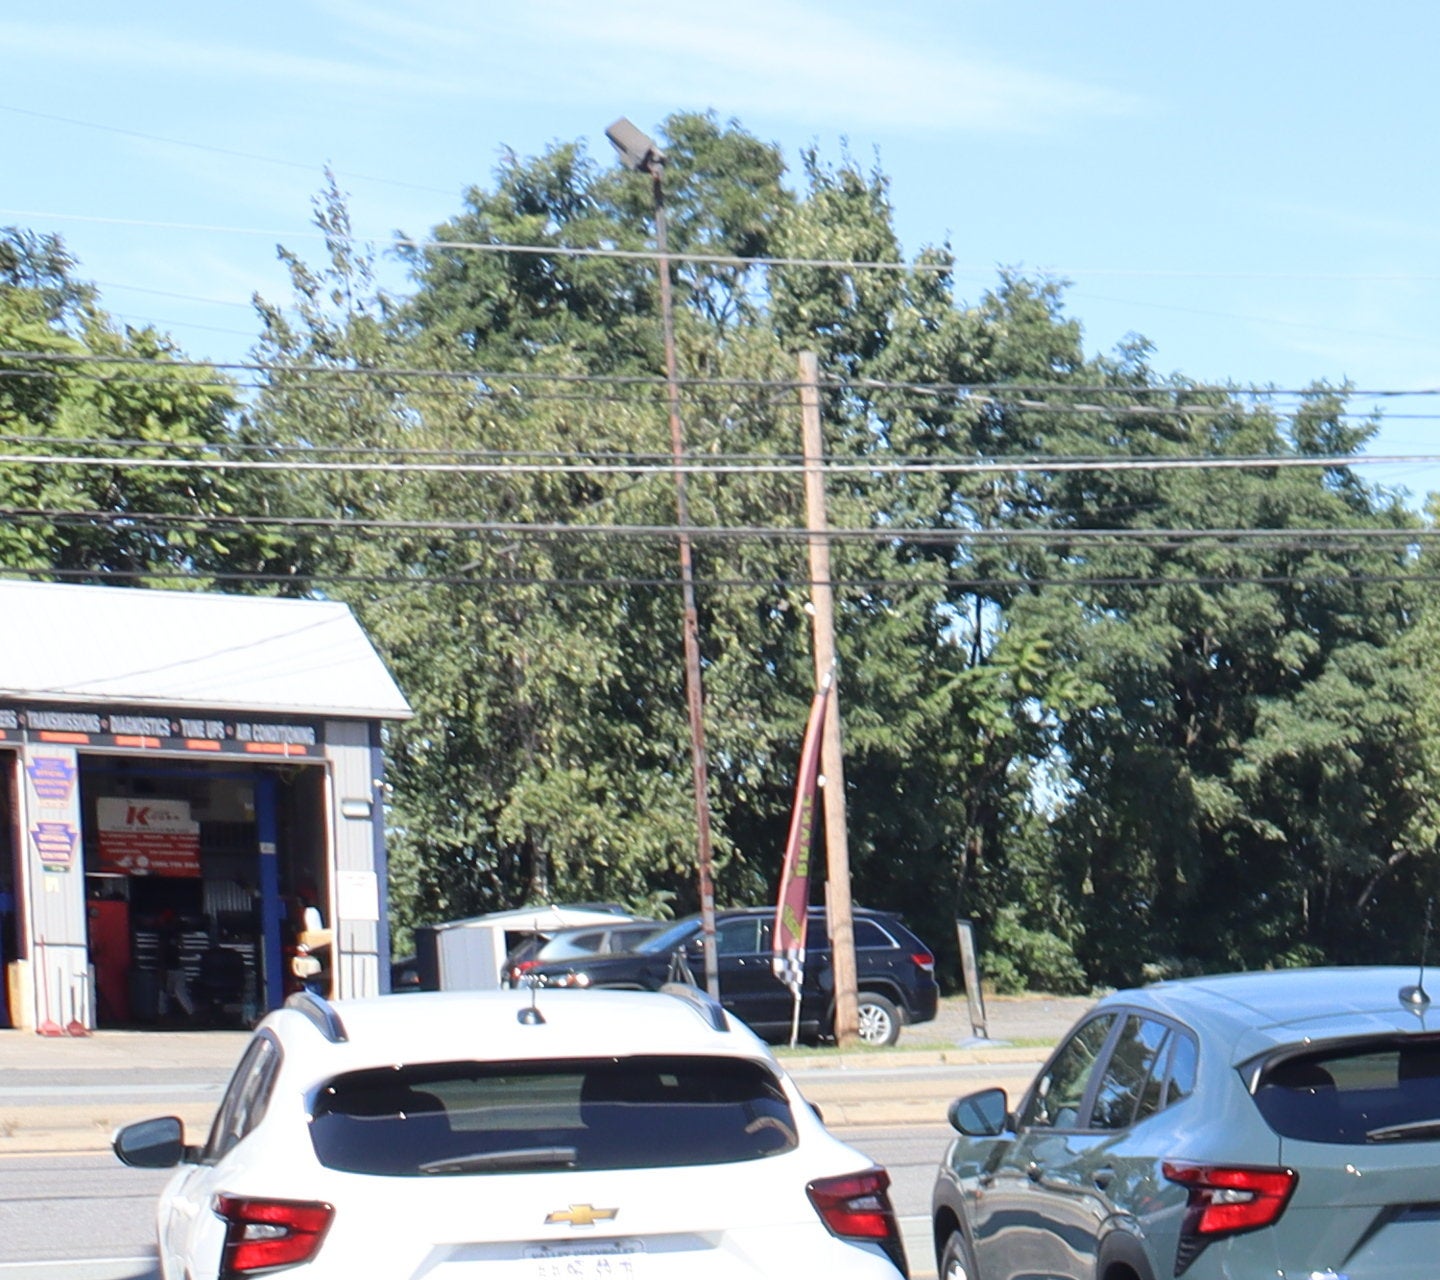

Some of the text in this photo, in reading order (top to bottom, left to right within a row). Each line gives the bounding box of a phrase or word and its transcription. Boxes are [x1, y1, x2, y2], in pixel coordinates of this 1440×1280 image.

[27, 711, 101, 732] TRANSMISSIONS
[109, 715, 171, 737] DIAGNOSTICS
[180, 718, 205, 738] TUNE
[207, 721, 226, 740] UPS
[236, 722, 251, 741] AIR
[252, 724, 316, 746] CONDITIONING
